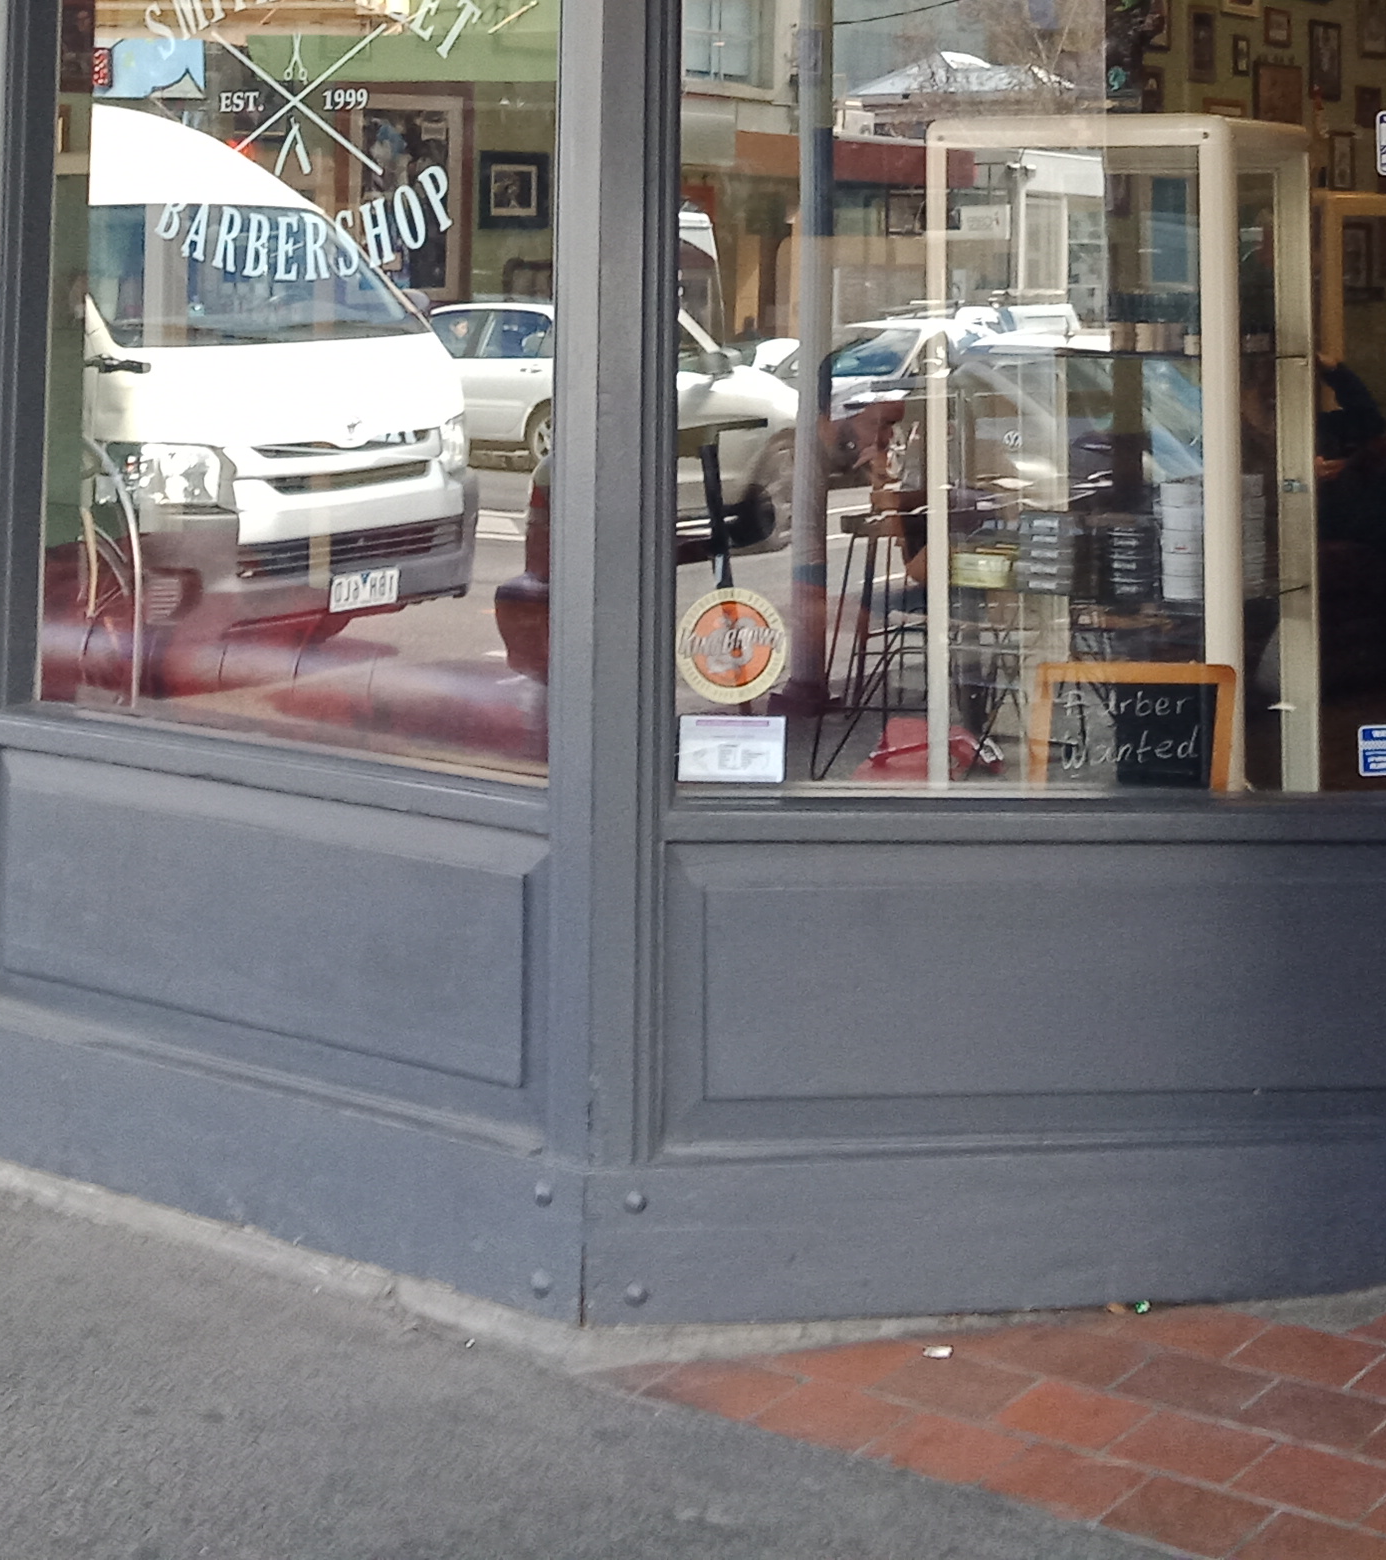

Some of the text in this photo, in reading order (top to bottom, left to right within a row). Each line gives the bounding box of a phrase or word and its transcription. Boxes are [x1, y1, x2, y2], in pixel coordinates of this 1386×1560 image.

[219, 88, 368, 113] EST. 1999
[155, 165, 454, 282] BARBERSHOP
